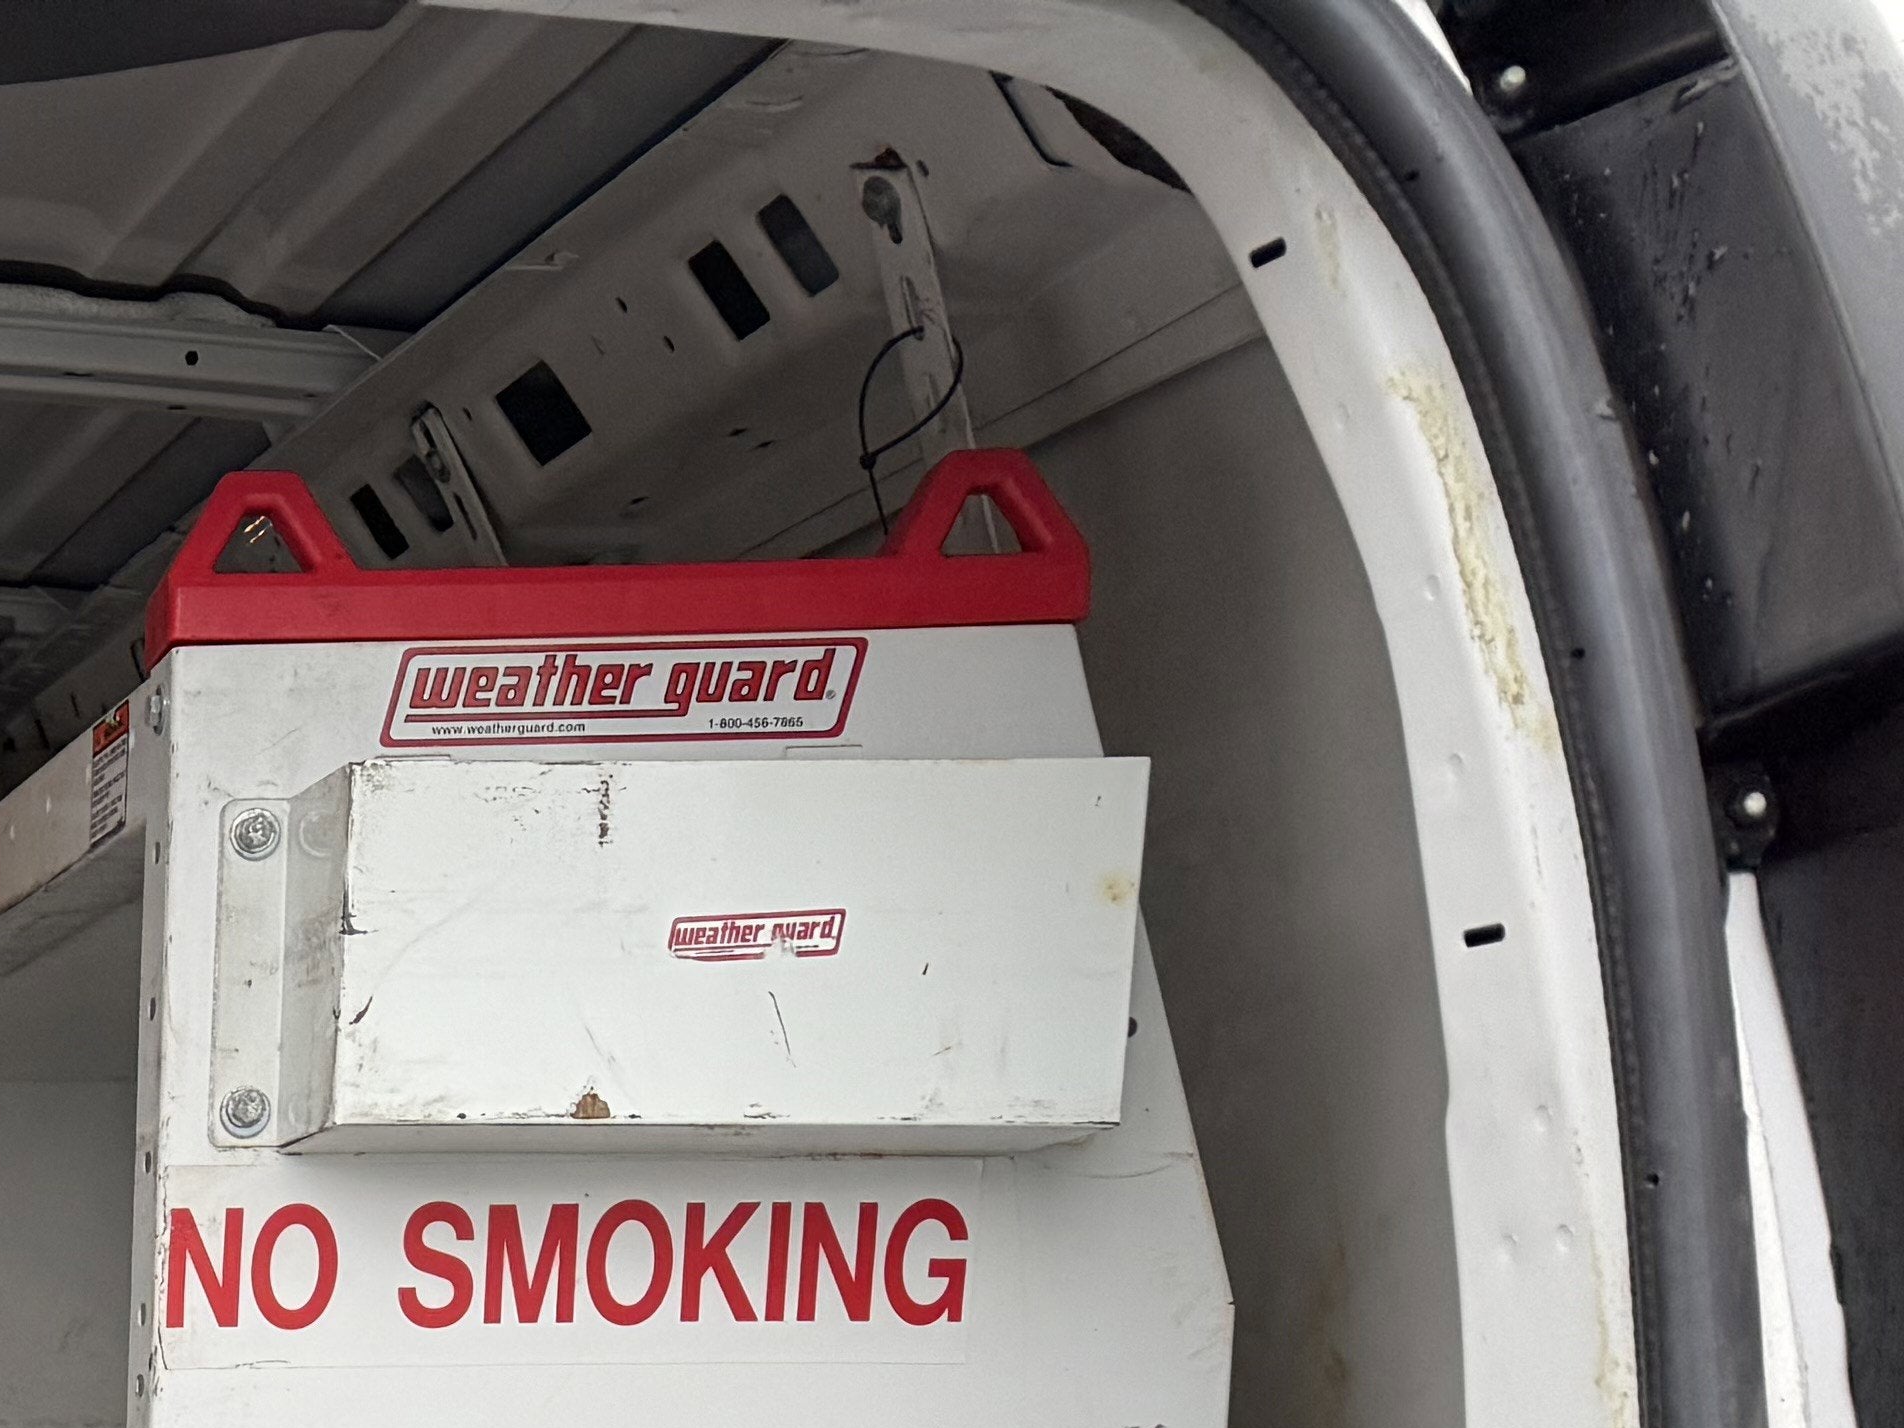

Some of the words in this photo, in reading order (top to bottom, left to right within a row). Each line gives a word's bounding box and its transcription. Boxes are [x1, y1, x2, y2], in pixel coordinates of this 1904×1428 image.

[409, 654, 653, 708] weather
[664, 647, 837, 717] guard
[675, 922, 765, 946] weather
[165, 1203, 339, 1330] NO
[397, 1199, 969, 1327] SMOKING
